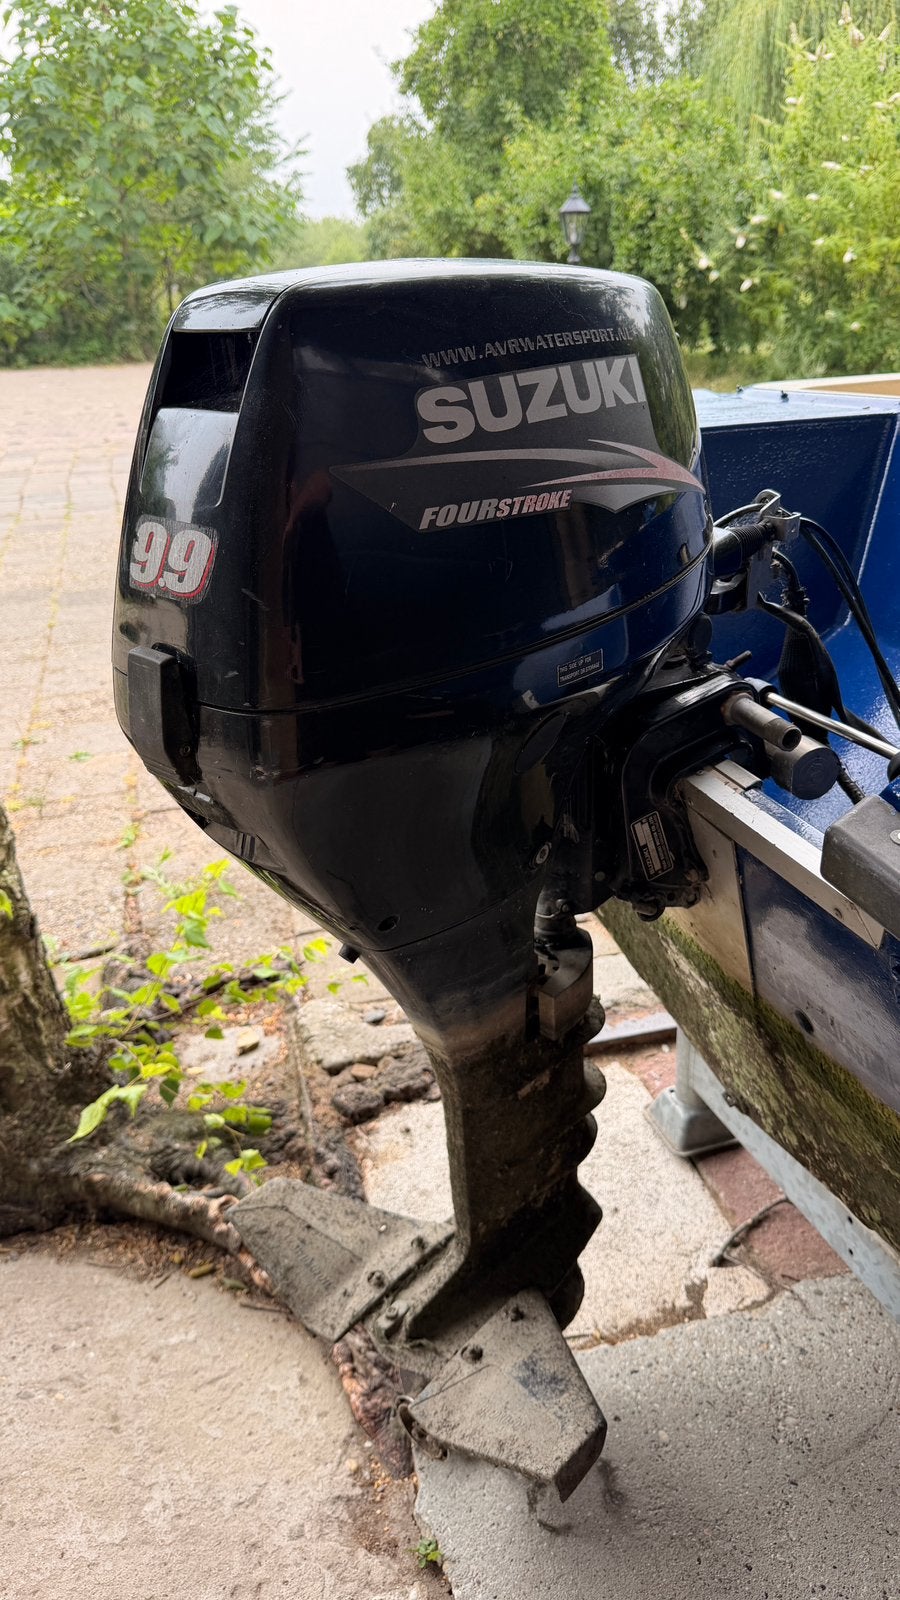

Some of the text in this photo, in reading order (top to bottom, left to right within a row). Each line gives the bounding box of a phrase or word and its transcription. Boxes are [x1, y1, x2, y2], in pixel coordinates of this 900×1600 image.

[421, 328, 633, 369] WWW.AVRWATERSPORT.NL
[417, 357, 647, 444] SUZUKI
[419, 489, 573, 530] FOURSTROKE
[129, 521, 215, 598] 9.9
